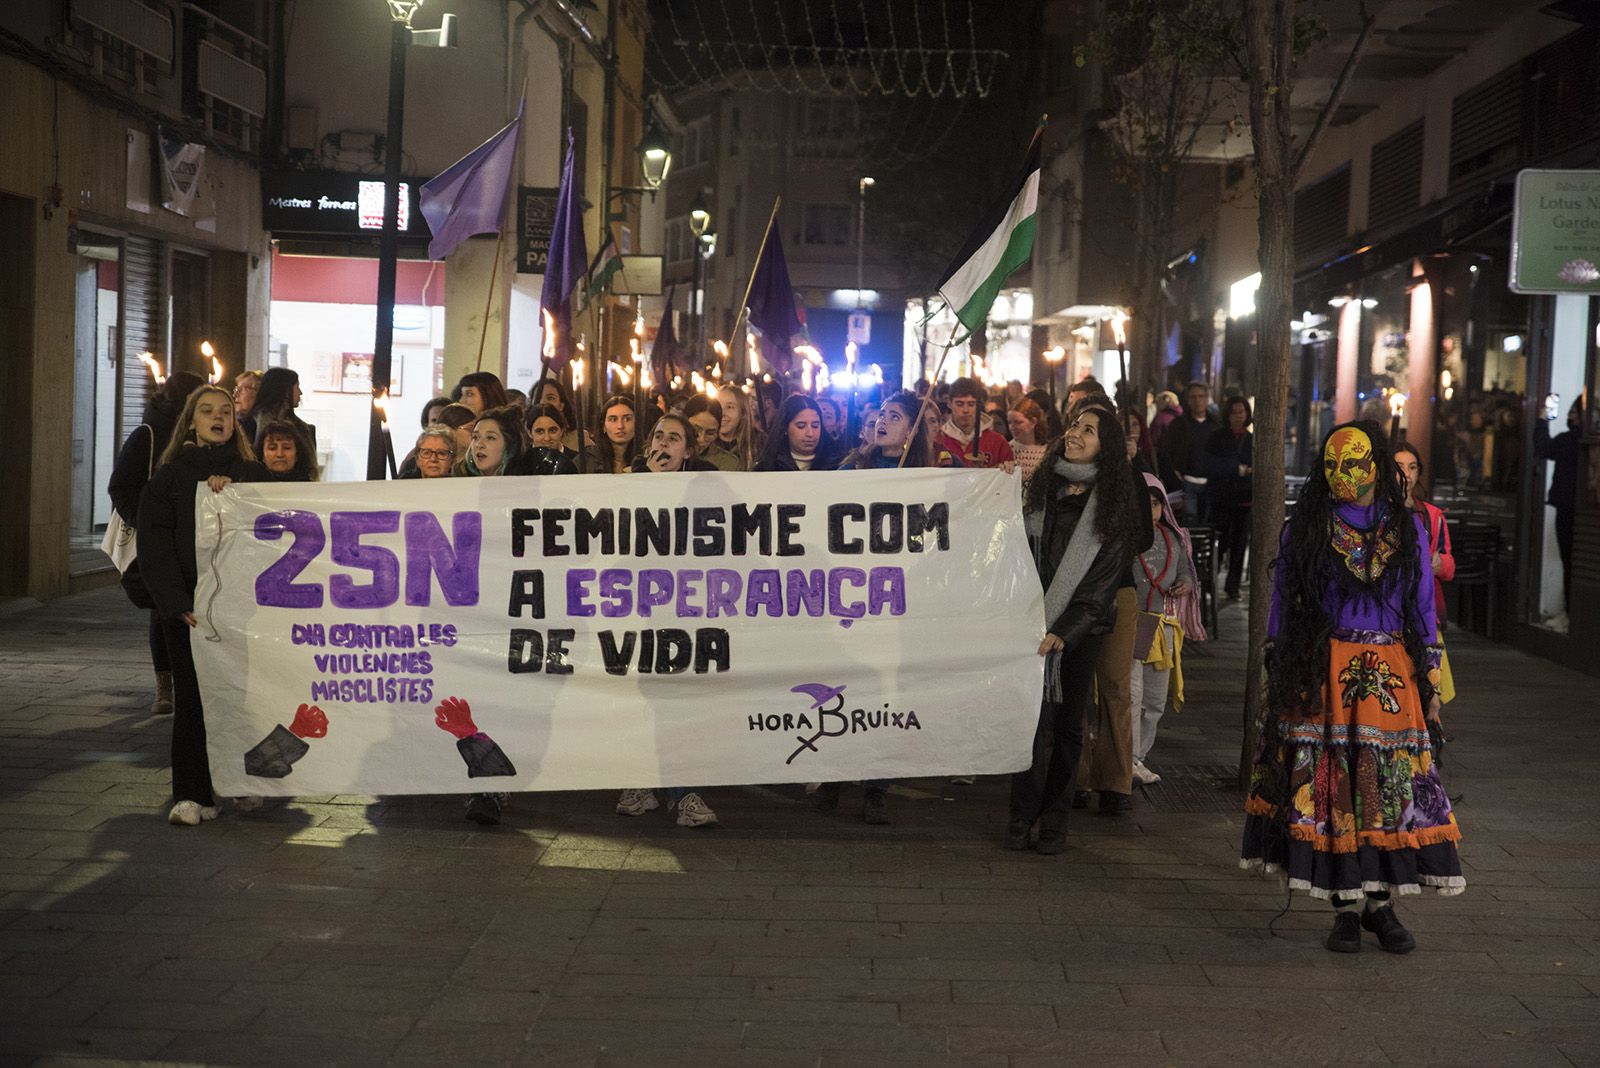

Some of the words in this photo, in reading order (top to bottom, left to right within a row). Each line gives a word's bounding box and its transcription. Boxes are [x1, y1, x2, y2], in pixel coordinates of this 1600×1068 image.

[269, 197, 312, 209] Mestres
[1540, 197, 1582, 210] Lotus
[1585, 197, 1600, 210] N
[511, 502, 806, 557] FEMINISME
[827, 501, 951, 555] COM
[254, 509, 482, 610] 25N
[508, 569, 546, 620] A
[566, 566, 907, 629] ESPERANÇA
[291, 623, 326, 647] DIA
[329, 622, 416, 649] CONTRA
[417, 623, 458, 647] LES
[508, 629, 575, 675] DE
[597, 627, 731, 676] VIDA
[310, 676, 434, 704] MASCLISTES
[748, 712, 813, 731] HORA
